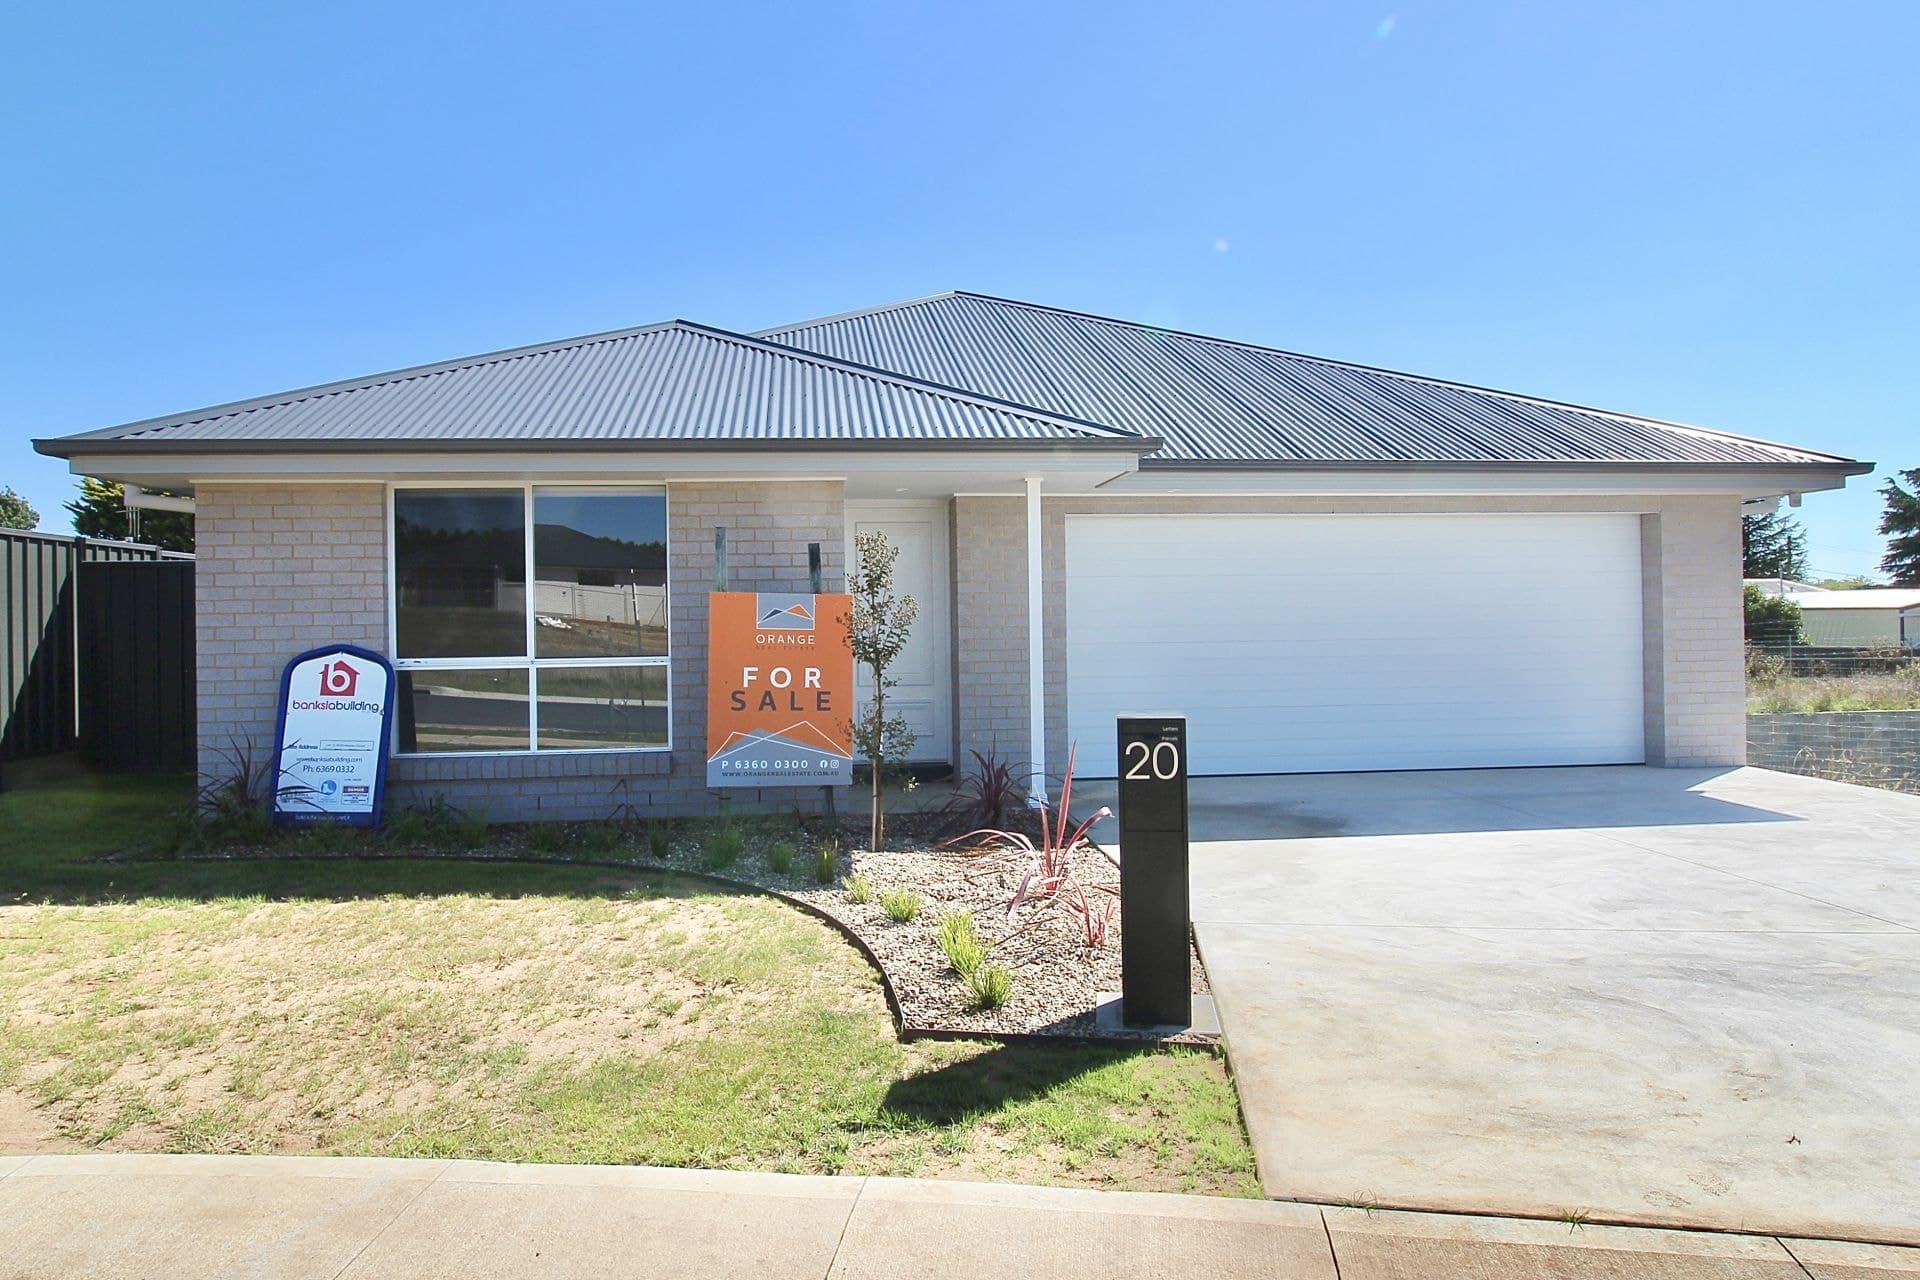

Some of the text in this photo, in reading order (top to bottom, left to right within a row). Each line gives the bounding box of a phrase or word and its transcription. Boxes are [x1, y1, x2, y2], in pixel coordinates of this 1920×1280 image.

[756, 634, 815, 645] ORANGE
[743, 667, 821, 689] FOR
[731, 690, 832, 711] SALE
[293, 701, 379, 713] banksiabuilding
[721, 760, 808, 769] P 6360 0300
[1125, 741, 1179, 779] 20
[315, 765, 335, 773] 6369
[336, 765, 355, 773] 0332
